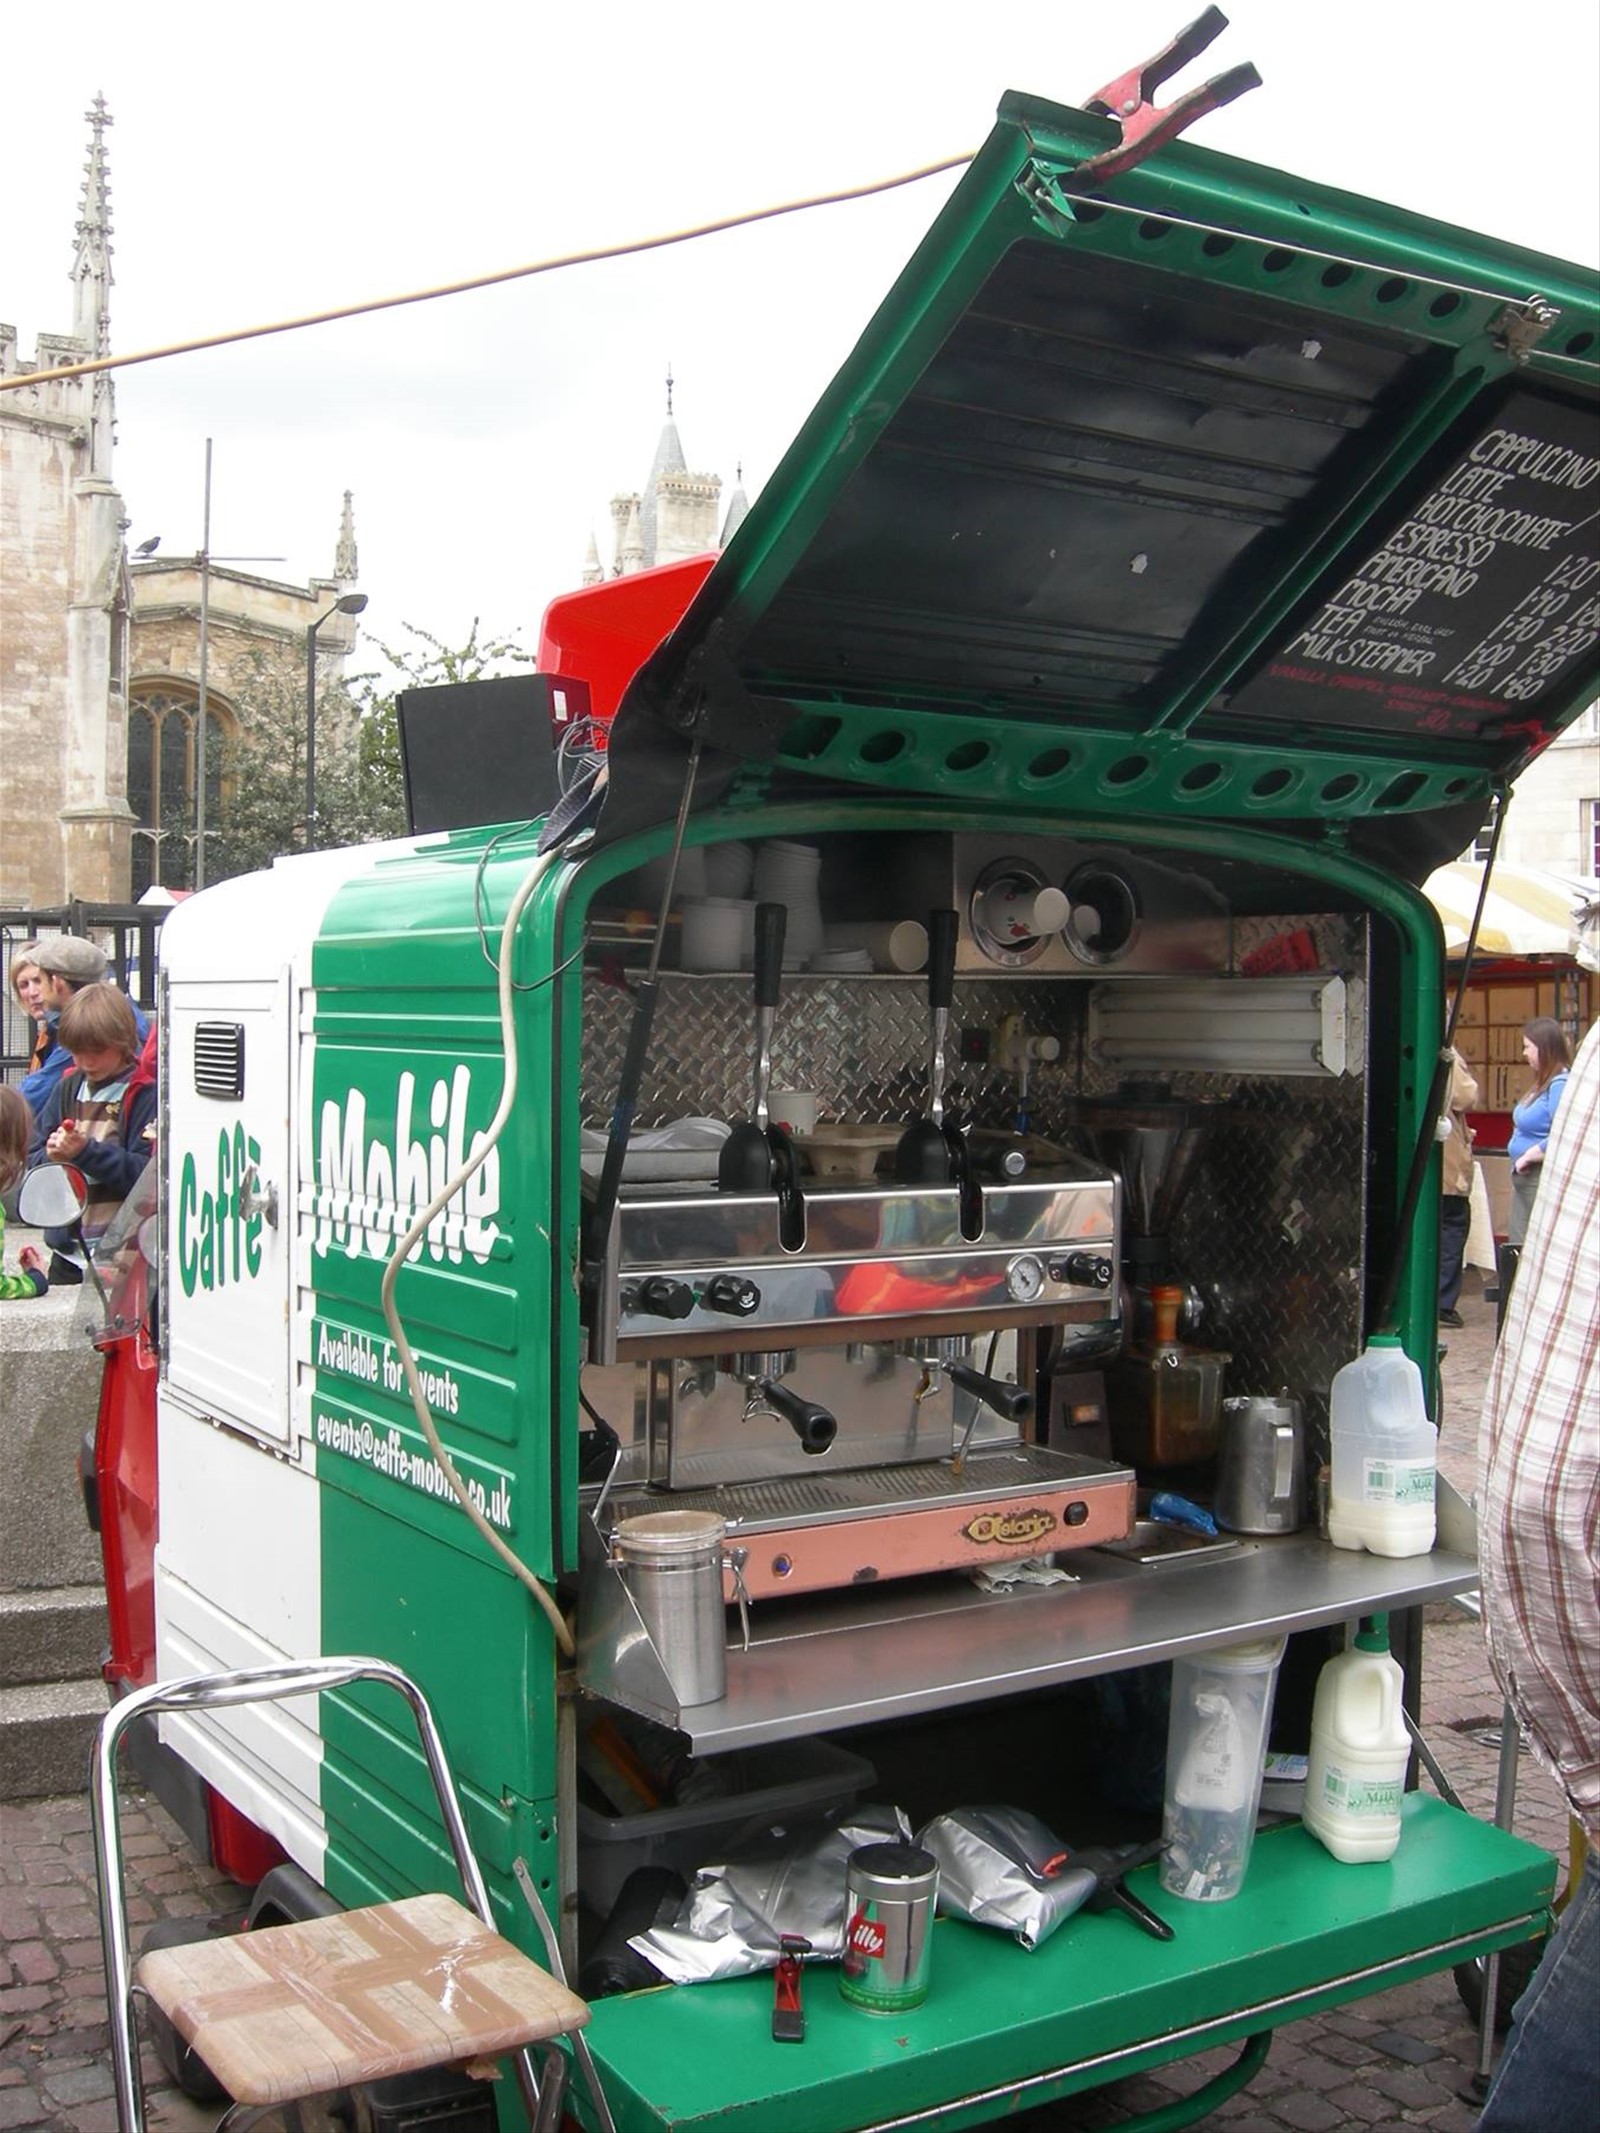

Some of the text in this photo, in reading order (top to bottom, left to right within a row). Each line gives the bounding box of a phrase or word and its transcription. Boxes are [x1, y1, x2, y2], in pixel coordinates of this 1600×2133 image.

[1469, 429, 1600, 489] CAPPUCCINO
[1440, 462, 1515, 503] LATTE
[1384, 521, 1496, 568] ESPRESSO
[1331, 578, 1422, 615] MOCHA
[1356, 550, 1479, 598] AMERICANO
[1310, 603, 1367, 637] TEA
[1284, 632, 1349, 661] MILK
[1336, 638, 1436, 677] STEAMER
[315, 1064, 500, 1265] Mobile
[318, 1323, 378, 1383] Available
[383, 1341, 404, 1392] for
[853, 1924, 884, 1954] illy
